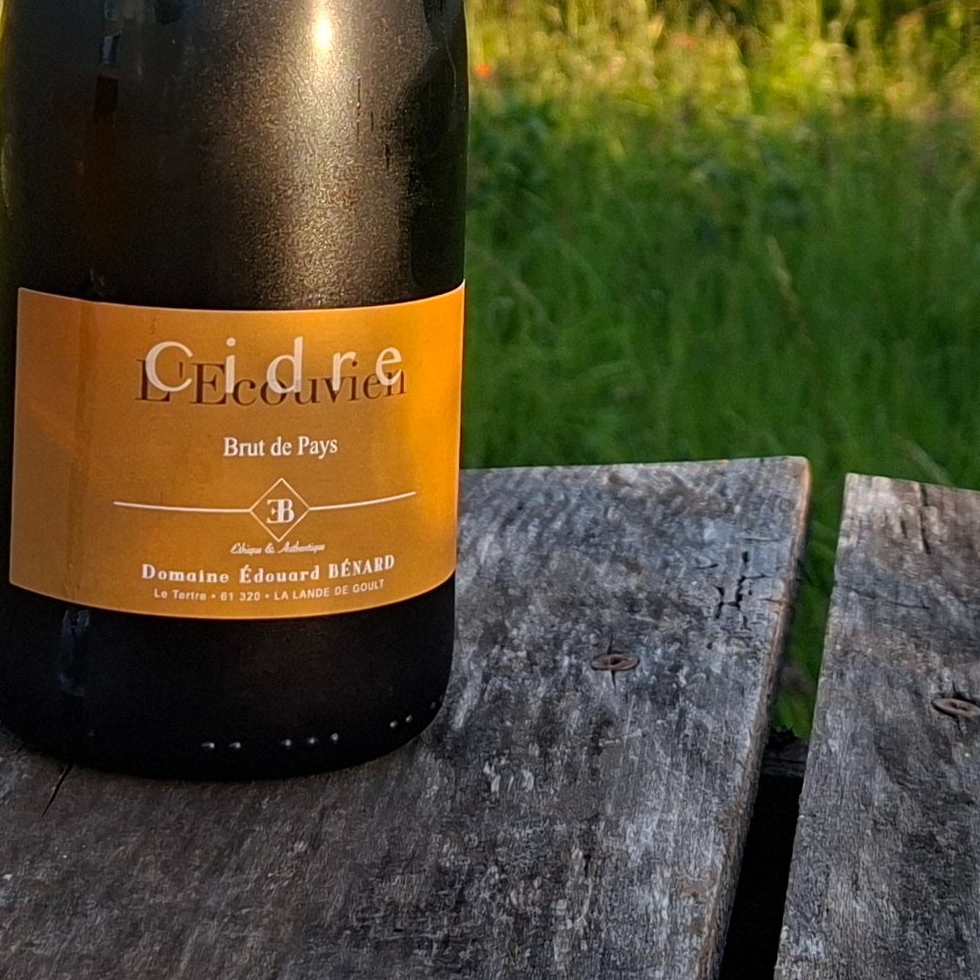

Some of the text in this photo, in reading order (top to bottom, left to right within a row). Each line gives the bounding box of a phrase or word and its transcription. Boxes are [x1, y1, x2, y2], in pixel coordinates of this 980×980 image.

[145, 336, 402, 394] Cidre
[223, 436, 338, 458] Brut de Pays
[142, 554, 395, 584] Domaine Édouard BÉNARD
[154, 588, 168, 598] Le
[220, 591, 234, 601] 61
[239, 591, 261, 601] 320
[274, 590, 289, 601] LA
[292, 587, 330, 600] LANDE
[334, 584, 349, 596] DE
[352, 578, 385, 593] GOULT
